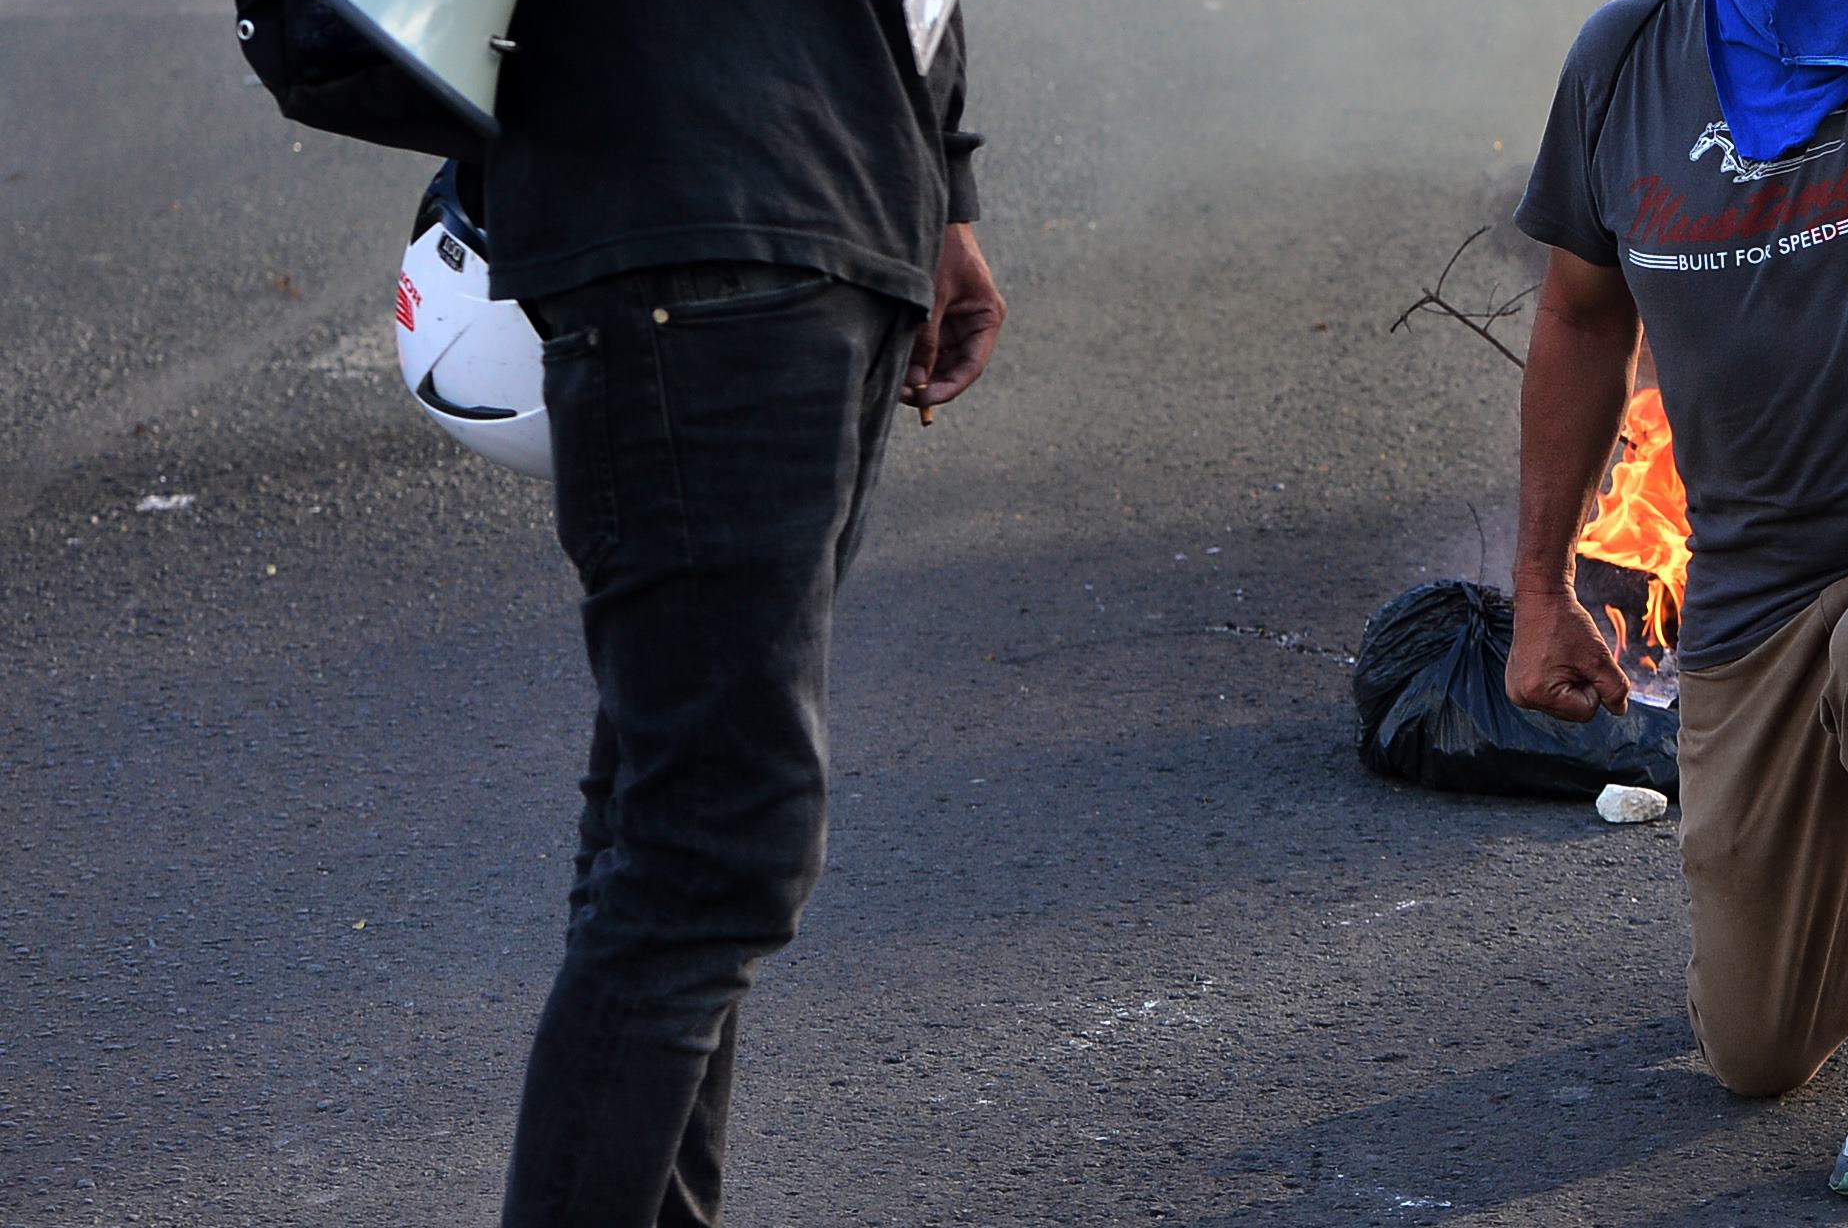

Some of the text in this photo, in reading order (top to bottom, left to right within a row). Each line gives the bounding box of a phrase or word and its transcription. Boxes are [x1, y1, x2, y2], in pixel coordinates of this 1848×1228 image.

[1678, 222, 1838, 272] BUILT FOR SPEED
